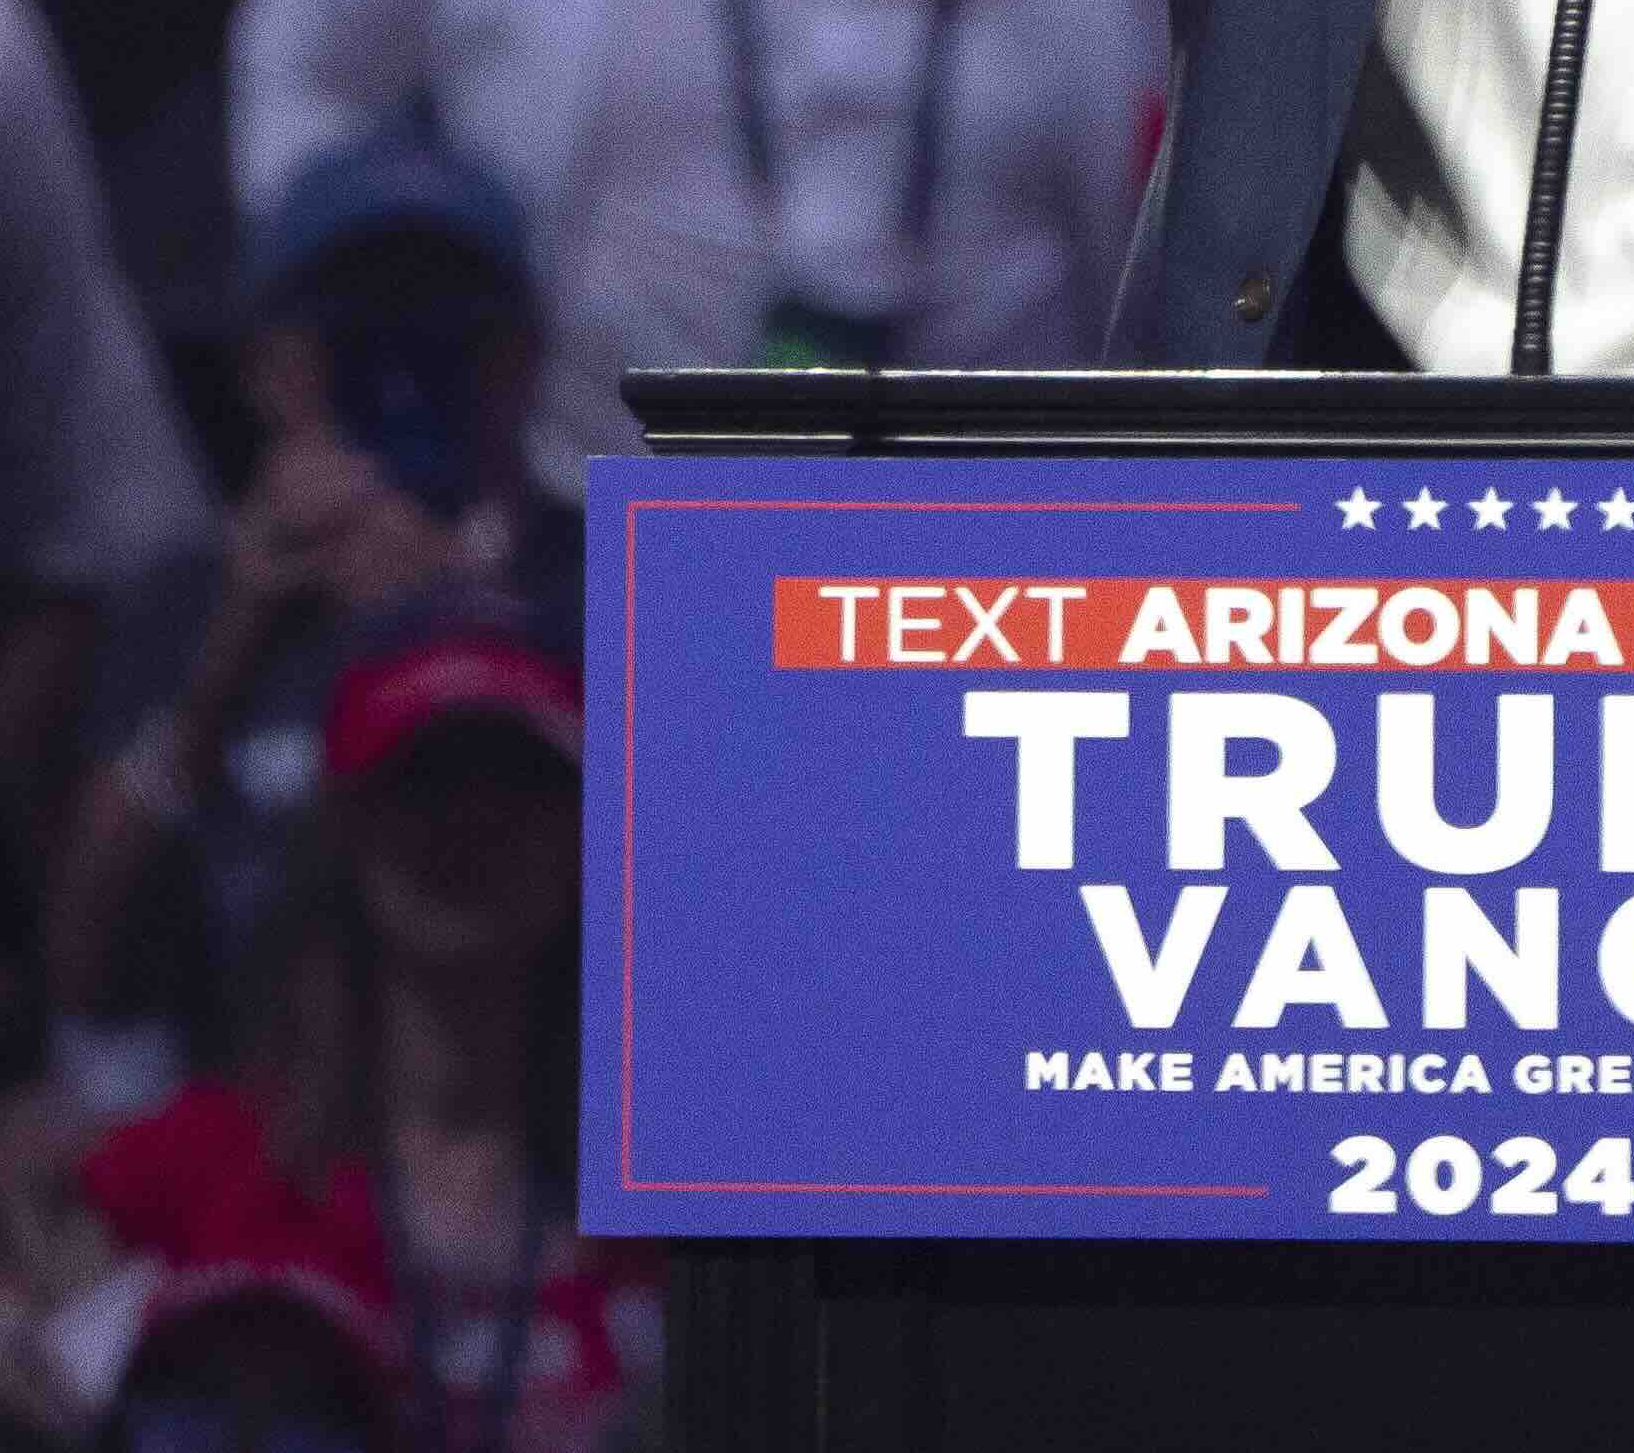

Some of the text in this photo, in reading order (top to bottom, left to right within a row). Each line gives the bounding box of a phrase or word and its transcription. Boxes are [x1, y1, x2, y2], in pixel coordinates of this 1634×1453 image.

[818, 585, 1087, 663] TEXT
[1118, 586, 1624, 667] ARIZONA
[1026, 1051, 1194, 1092] MAKE
[1215, 1052, 1492, 1094] AMERICA
